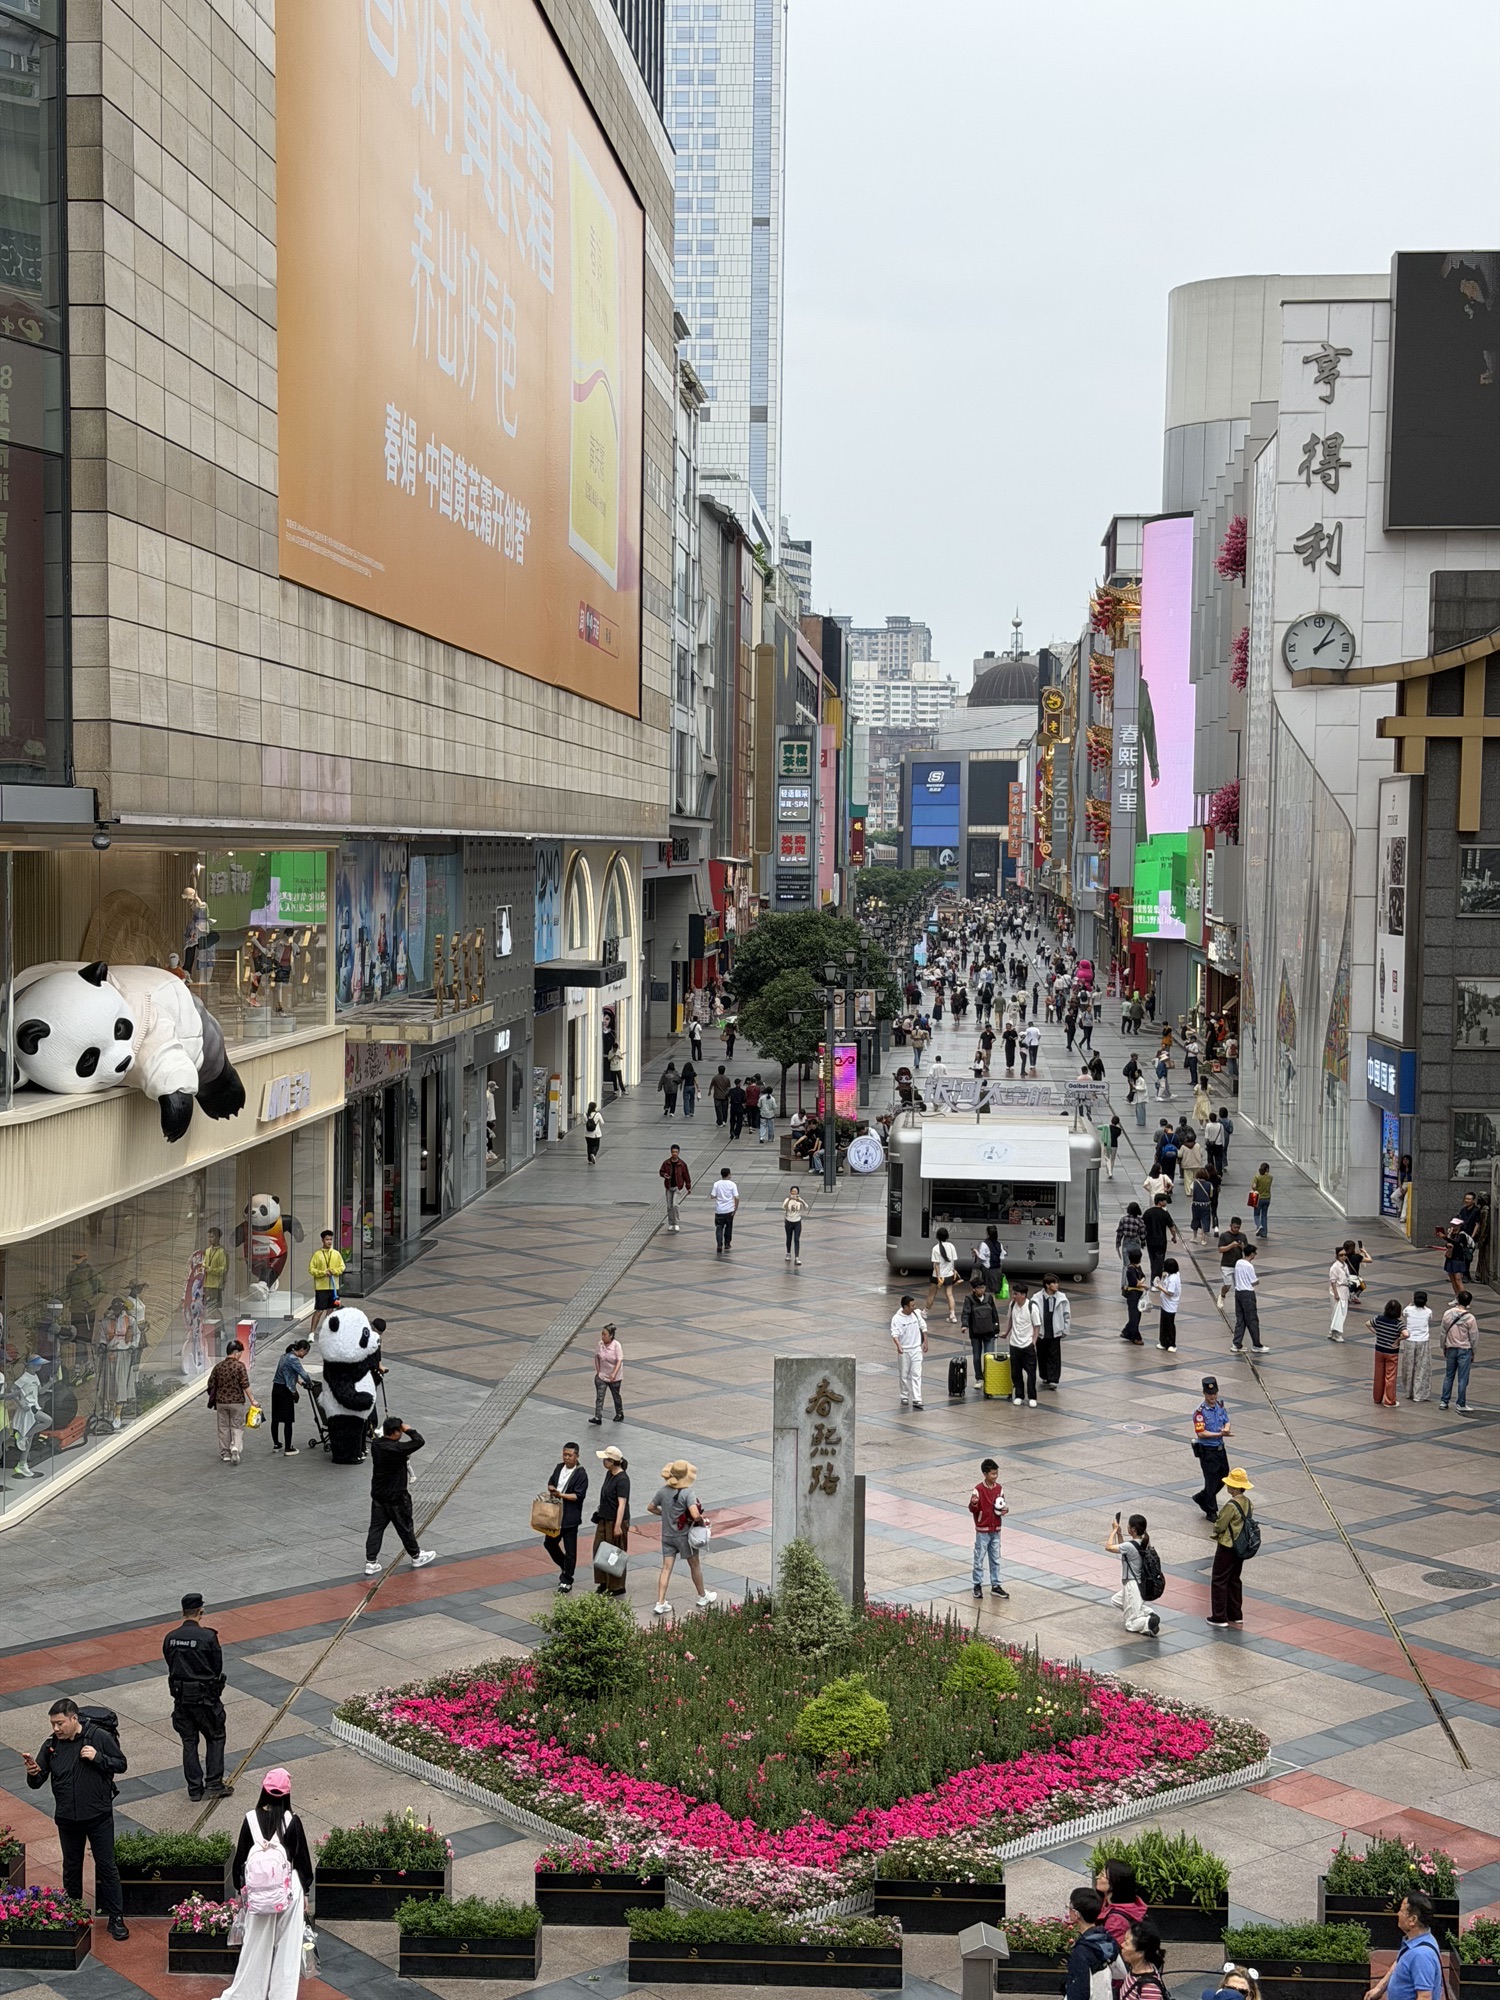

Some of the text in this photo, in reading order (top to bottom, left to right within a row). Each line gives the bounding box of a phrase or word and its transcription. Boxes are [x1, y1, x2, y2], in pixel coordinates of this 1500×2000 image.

[410, 170, 518, 439] 养出好气色
[1294, 342, 1353, 577] 亨得利
[1117, 724, 1139, 813] 春熙北里
[923, 1076, 1052, 1112] 银河太空舱
[805, 1377, 845, 1495] 春熙路
